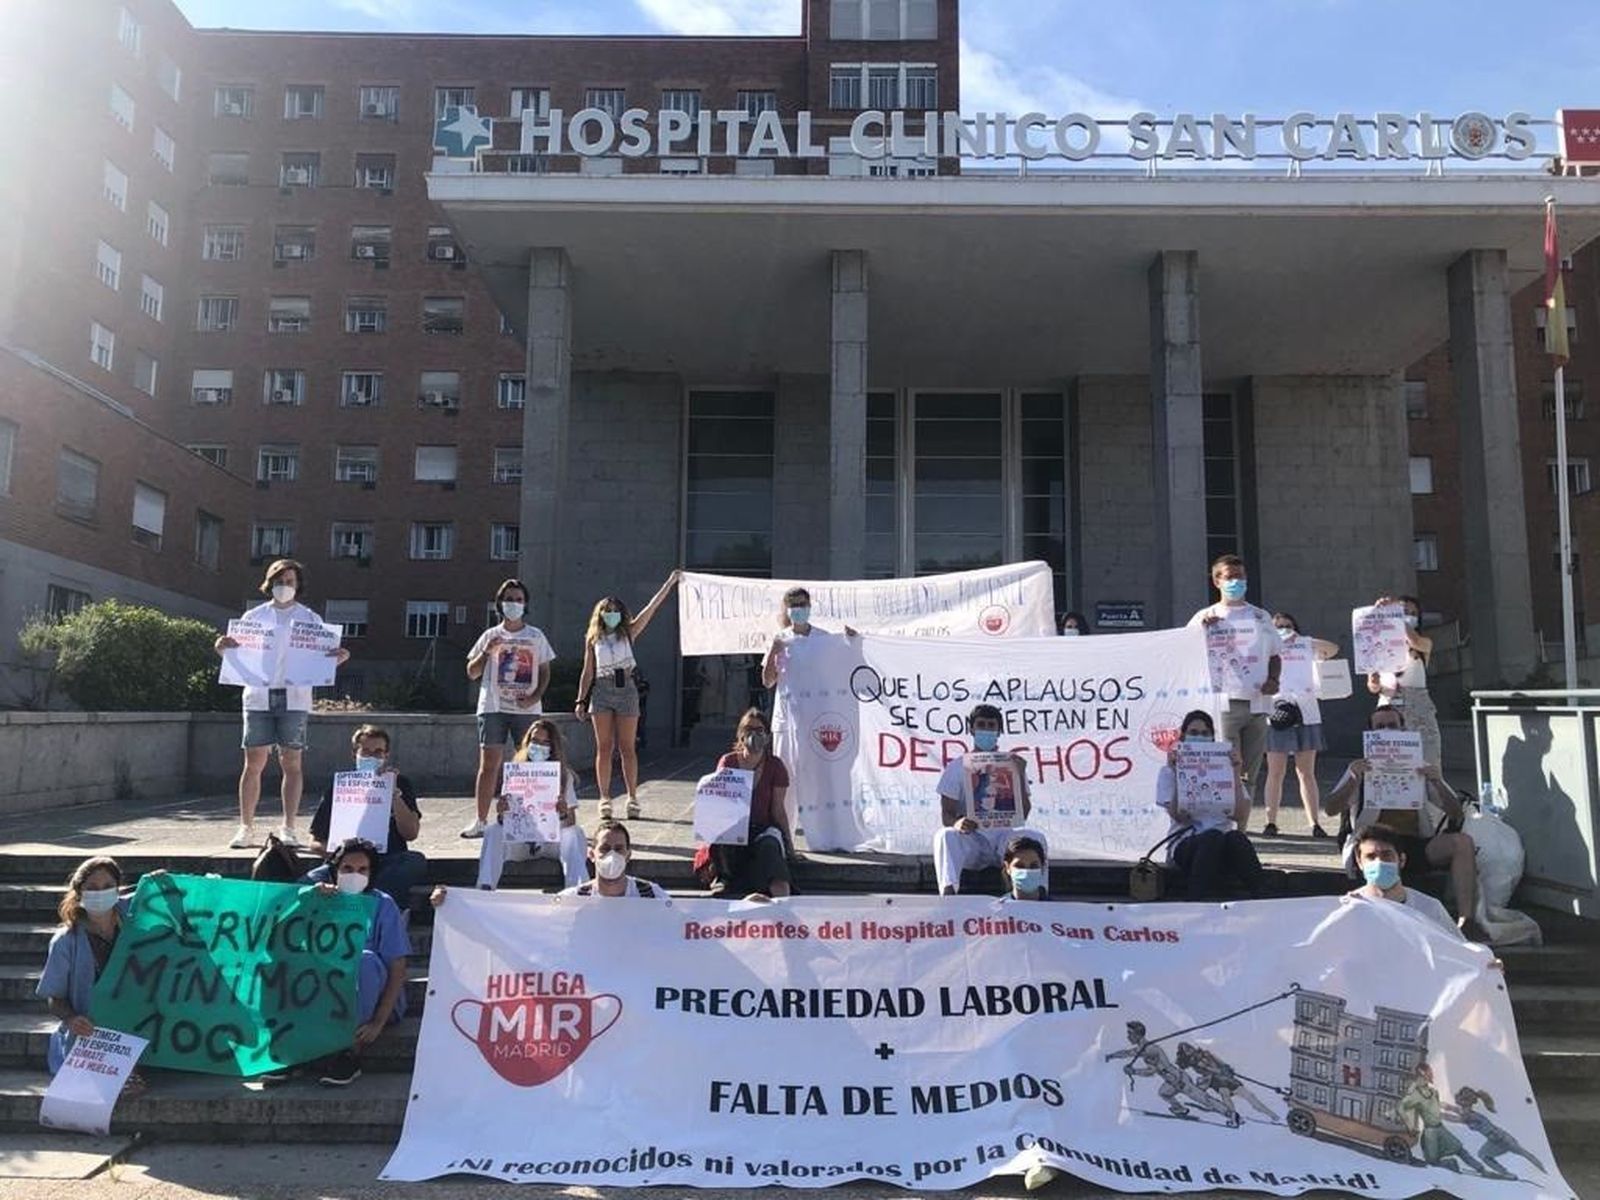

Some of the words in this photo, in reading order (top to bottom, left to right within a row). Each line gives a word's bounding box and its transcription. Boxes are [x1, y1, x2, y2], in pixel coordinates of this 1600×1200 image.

[519, 108, 825, 158] HOSPITAL
[849, 110, 1100, 159] CLINICO
[1128, 112, 1256, 160] SAN
[1282, 111, 1537, 161] CARLOS
[1129, 609, 1140, 620] A
[850, 665, 909, 704] QUE
[917, 674, 970, 702] LOS
[983, 675, 1144, 703] APLAUSOS
[890, 705, 919, 729] SE
[926, 706, 1086, 736] CONIERTAN
[1096, 707, 1129, 731] EN
[878, 732, 1133, 784] DERHOS
[684, 921, 810, 940] Residentes
[818, 921, 852, 940] del
[861, 920, 954, 943] Hospital
[962, 916, 1042, 937] Clínico
[1050, 923, 1095, 941] San
[1103, 925, 1180, 944] Carlos
[487, 971, 586, 998] HUELGA
[655, 986, 926, 1019] PRECARIEDAD
[940, 978, 1119, 1017] LABORAL
[93, 1029, 122, 1042] TIMIZA
[489, 1003, 583, 1042] MIR
[493, 1041, 572, 1059] MADRID
[874, 1042, 895, 1061] +
[709, 1080, 829, 1116] FALTA
[843, 1086, 898, 1116] DE
[911, 1072, 1064, 1115] MEDIOS
[502, 1146, 693, 1175] reconocidos
[704, 1156, 734, 1175] ni
[744, 1160, 903, 1178] valorados
[914, 1156, 968, 1181] por
[976, 1142, 1006, 1165] la
[1015, 1132, 1193, 1183] Comunidad
[1202, 1166, 1242, 1185] de
